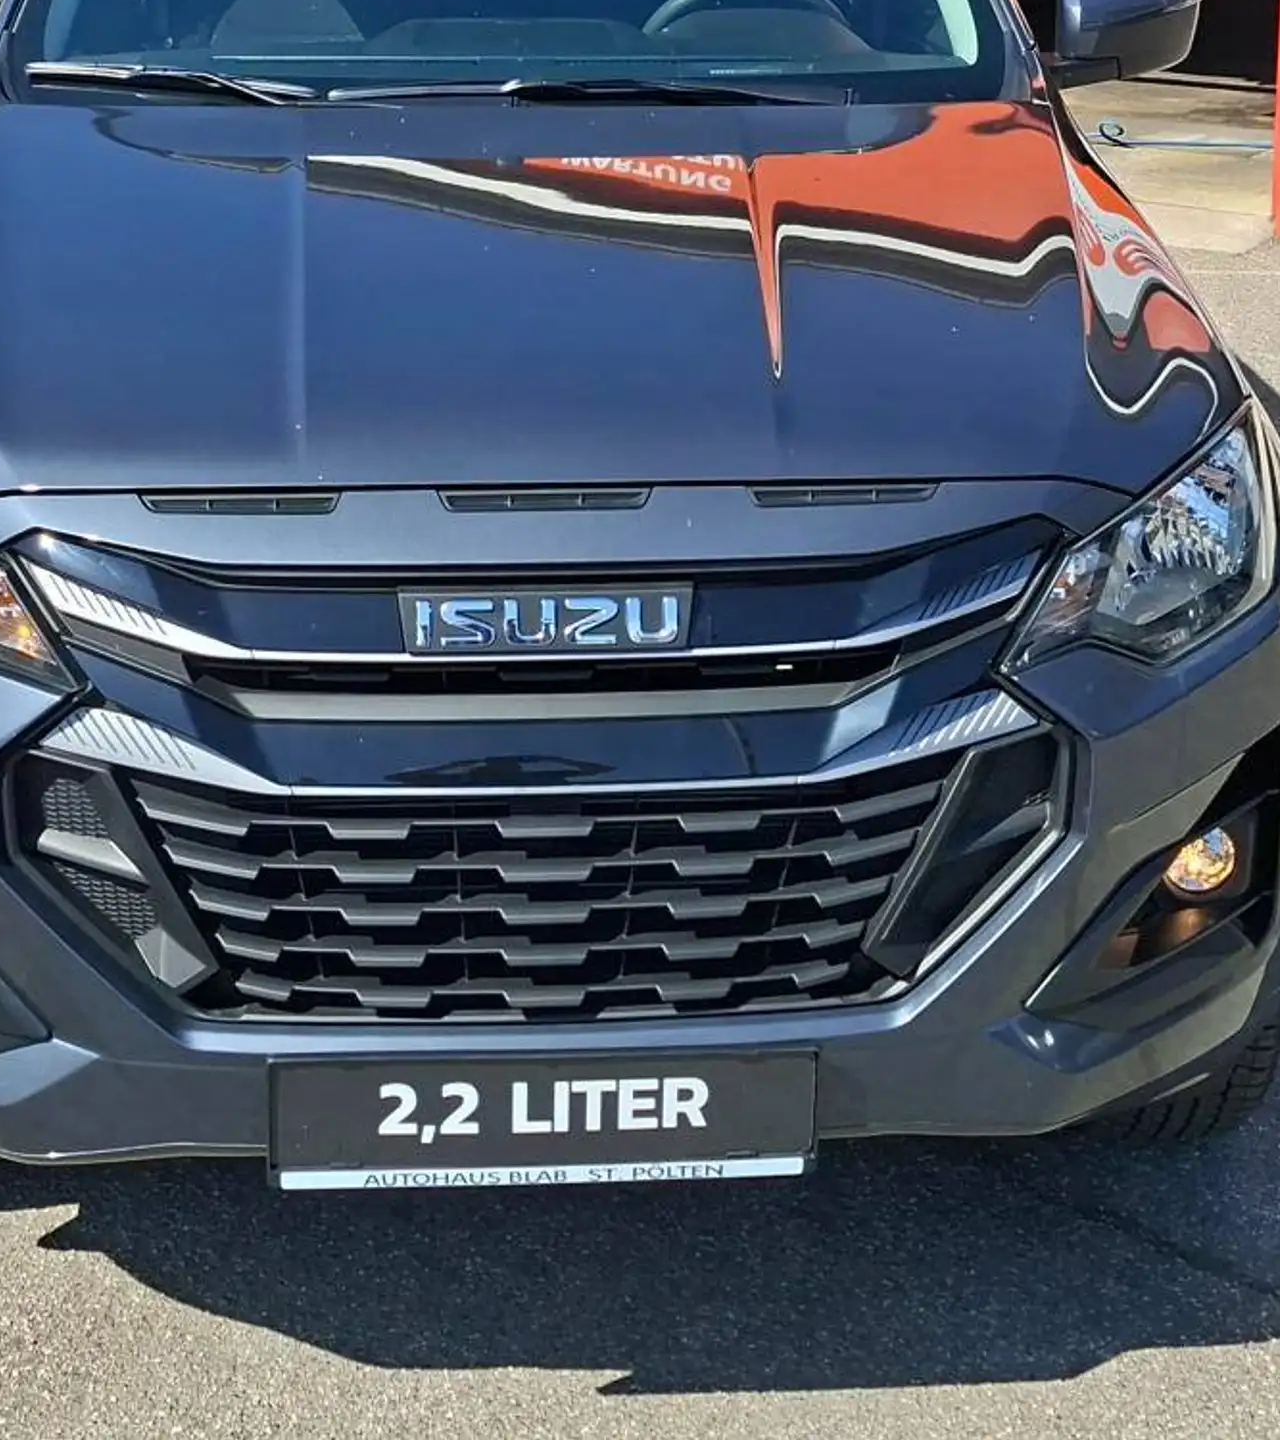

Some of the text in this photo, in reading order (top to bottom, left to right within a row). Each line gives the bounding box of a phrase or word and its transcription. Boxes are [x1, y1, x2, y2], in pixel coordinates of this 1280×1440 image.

[415, 596, 679, 647] ISUZU
[377, 1077, 710, 1144] 2,2 LITER
[363, 1170, 501, 1187] AUTOHAUS
[508, 1169, 567, 1184] BLAB
